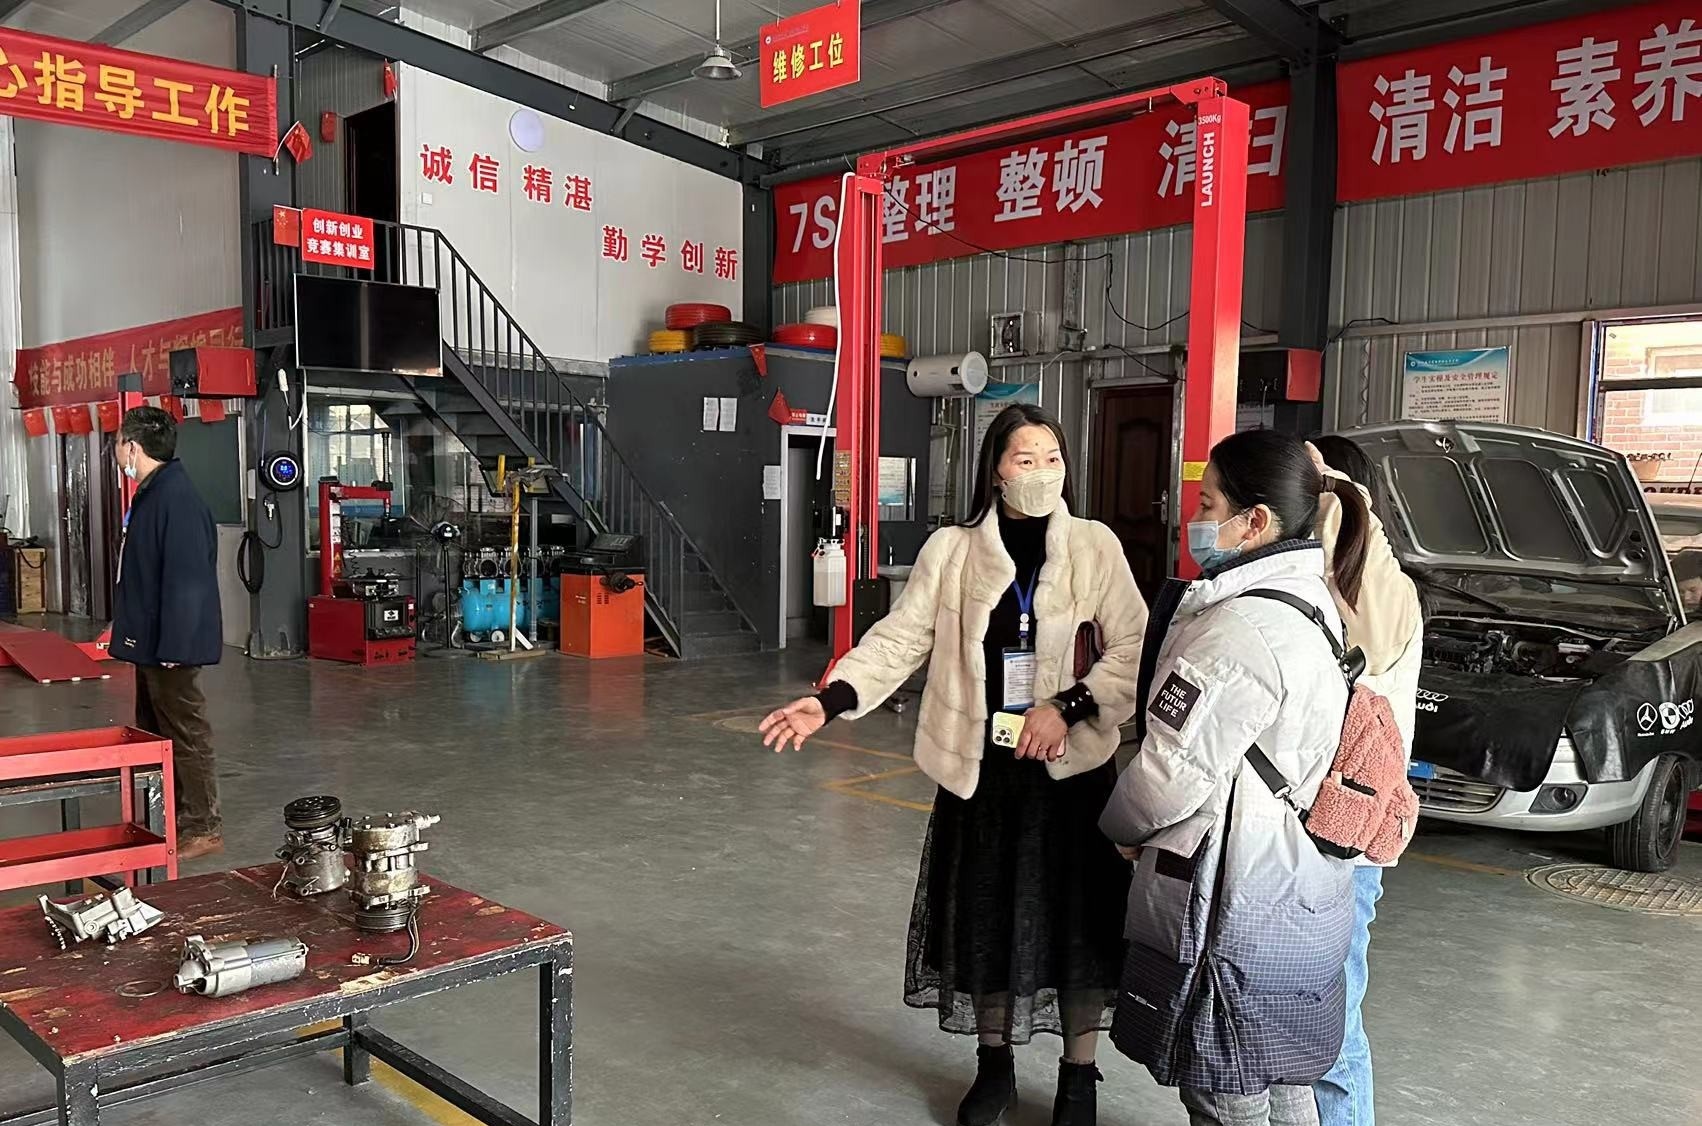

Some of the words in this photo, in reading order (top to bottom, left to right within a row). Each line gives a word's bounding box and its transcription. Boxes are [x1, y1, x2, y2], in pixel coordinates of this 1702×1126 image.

[773, 31, 843, 83] 维修工位
[1369, 56, 1507, 165] 清洁
[1549, 19, 1702, 138] 素养
[1201, 131, 1215, 207] LAUNCH
[789, 195, 836, 253] 7S
[994, 136, 1107, 222] 整顿
[312, 217, 364, 239] 创新创业
[306, 237, 371, 261] 竞赛集训室
[1161, 689, 1187, 711] FUTUR
[1170, 684, 1187, 699] THE
[1159, 700, 1179, 718] LIFE
[1416, 702, 1438, 713] udi
